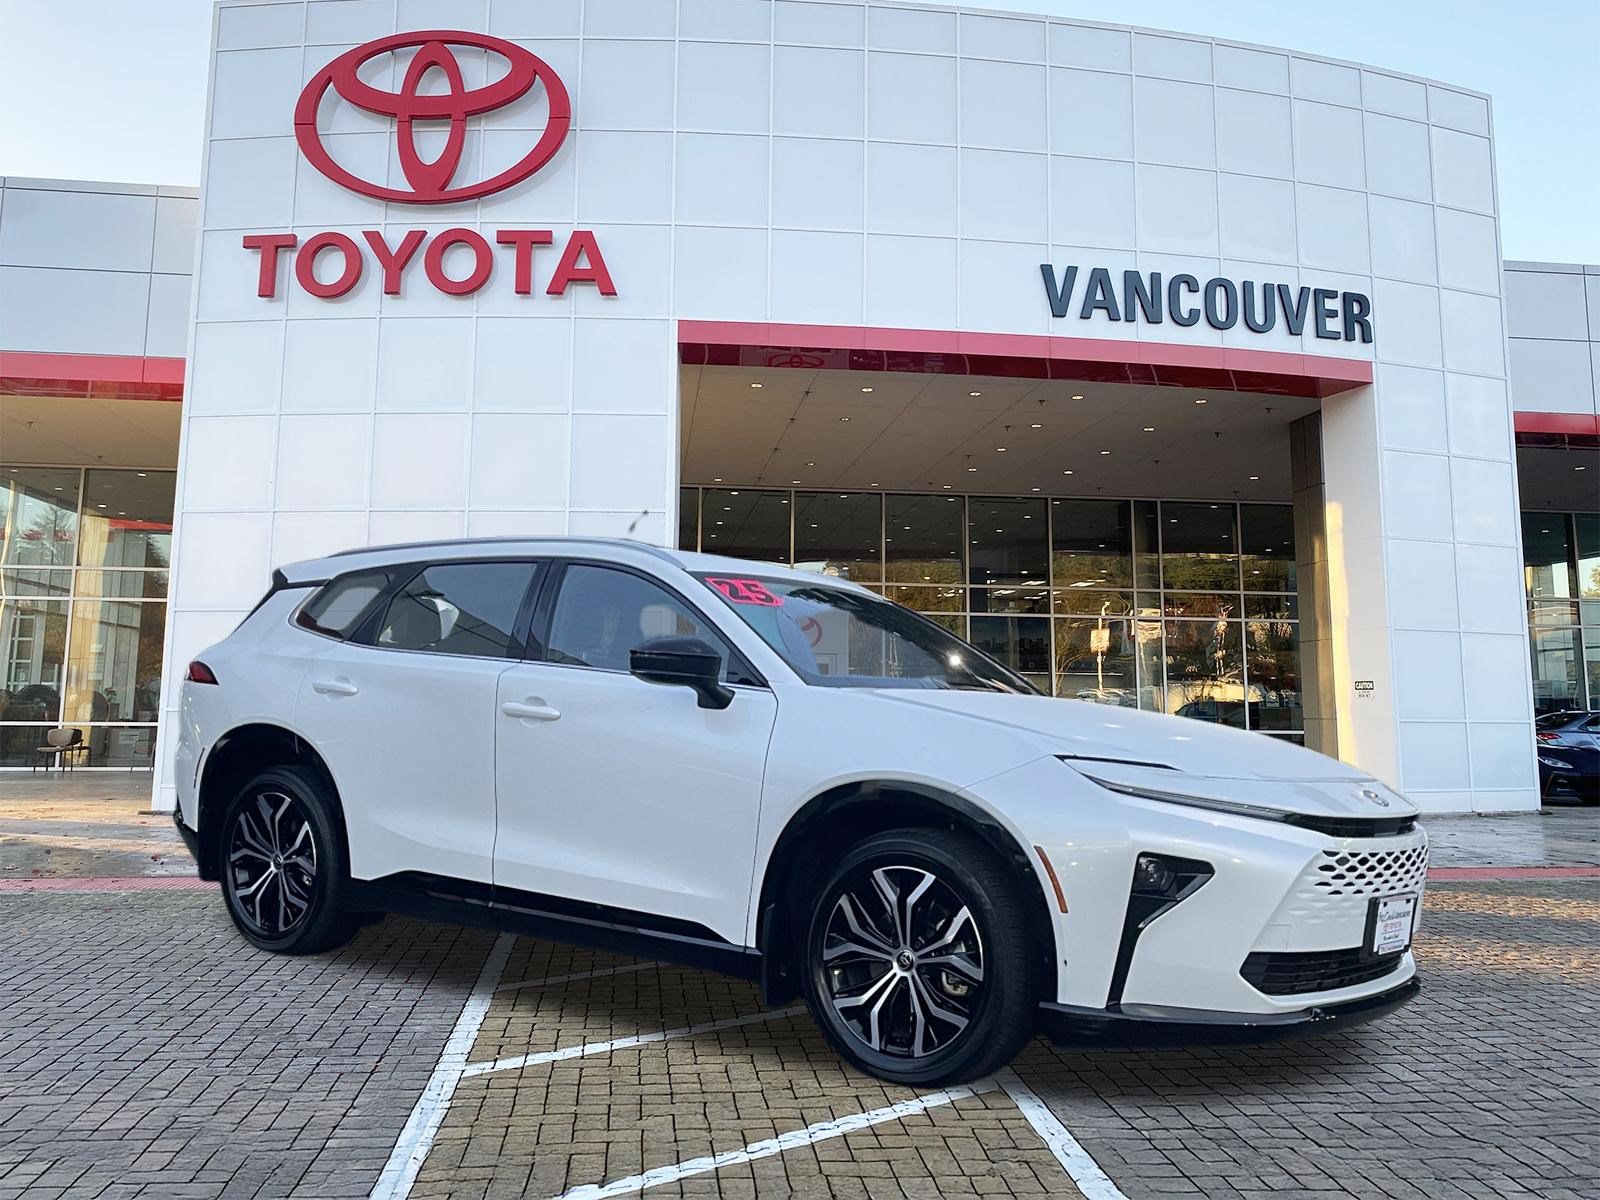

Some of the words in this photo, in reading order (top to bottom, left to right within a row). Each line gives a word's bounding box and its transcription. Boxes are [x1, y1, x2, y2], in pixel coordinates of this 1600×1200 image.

[243, 228, 618, 299] TOYOTA
[1040, 264, 1373, 344] VANCOUVER
[711, 579, 775, 605] 25
